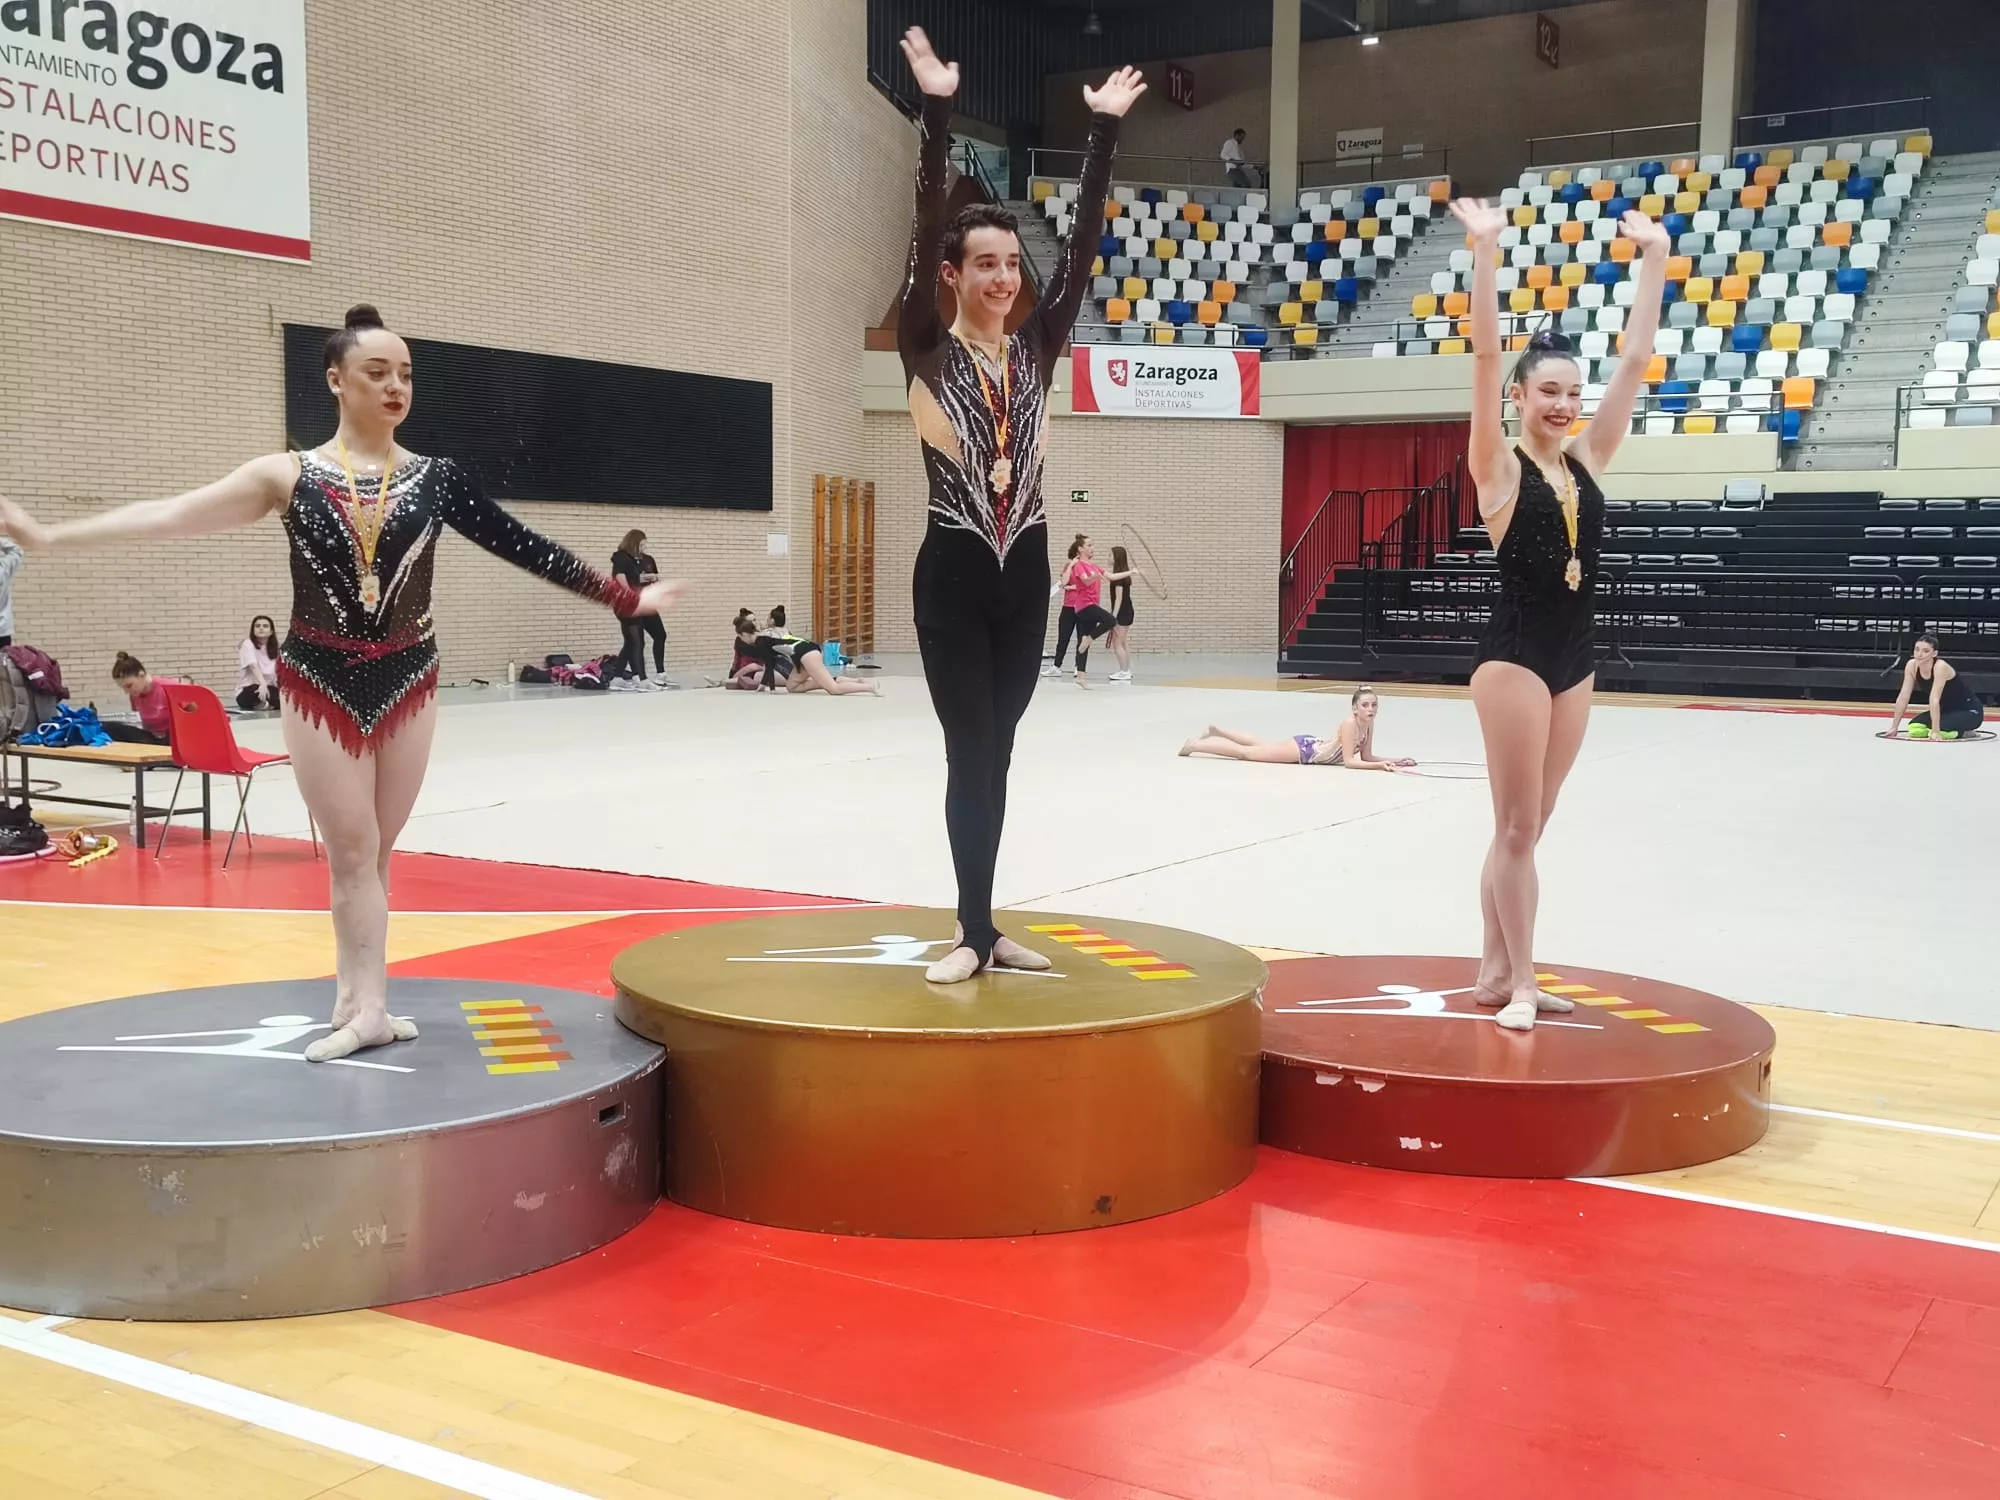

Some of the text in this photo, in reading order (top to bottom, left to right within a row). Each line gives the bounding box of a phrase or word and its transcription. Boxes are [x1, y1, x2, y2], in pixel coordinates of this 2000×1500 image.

[1, 0, 284, 94] aragoza
[1540, 21, 1551, 57] 12
[1170, 69, 1182, 100] 11
[0, 76, 237, 154] STALACIONES
[1347, 138, 1383, 149] Zaragoza
[1134, 362, 1218, 386] Zaragoza
[1135, 387, 1205, 399] INSTALACIONES
[1135, 397, 1193, 409] DEPORTIVAS
